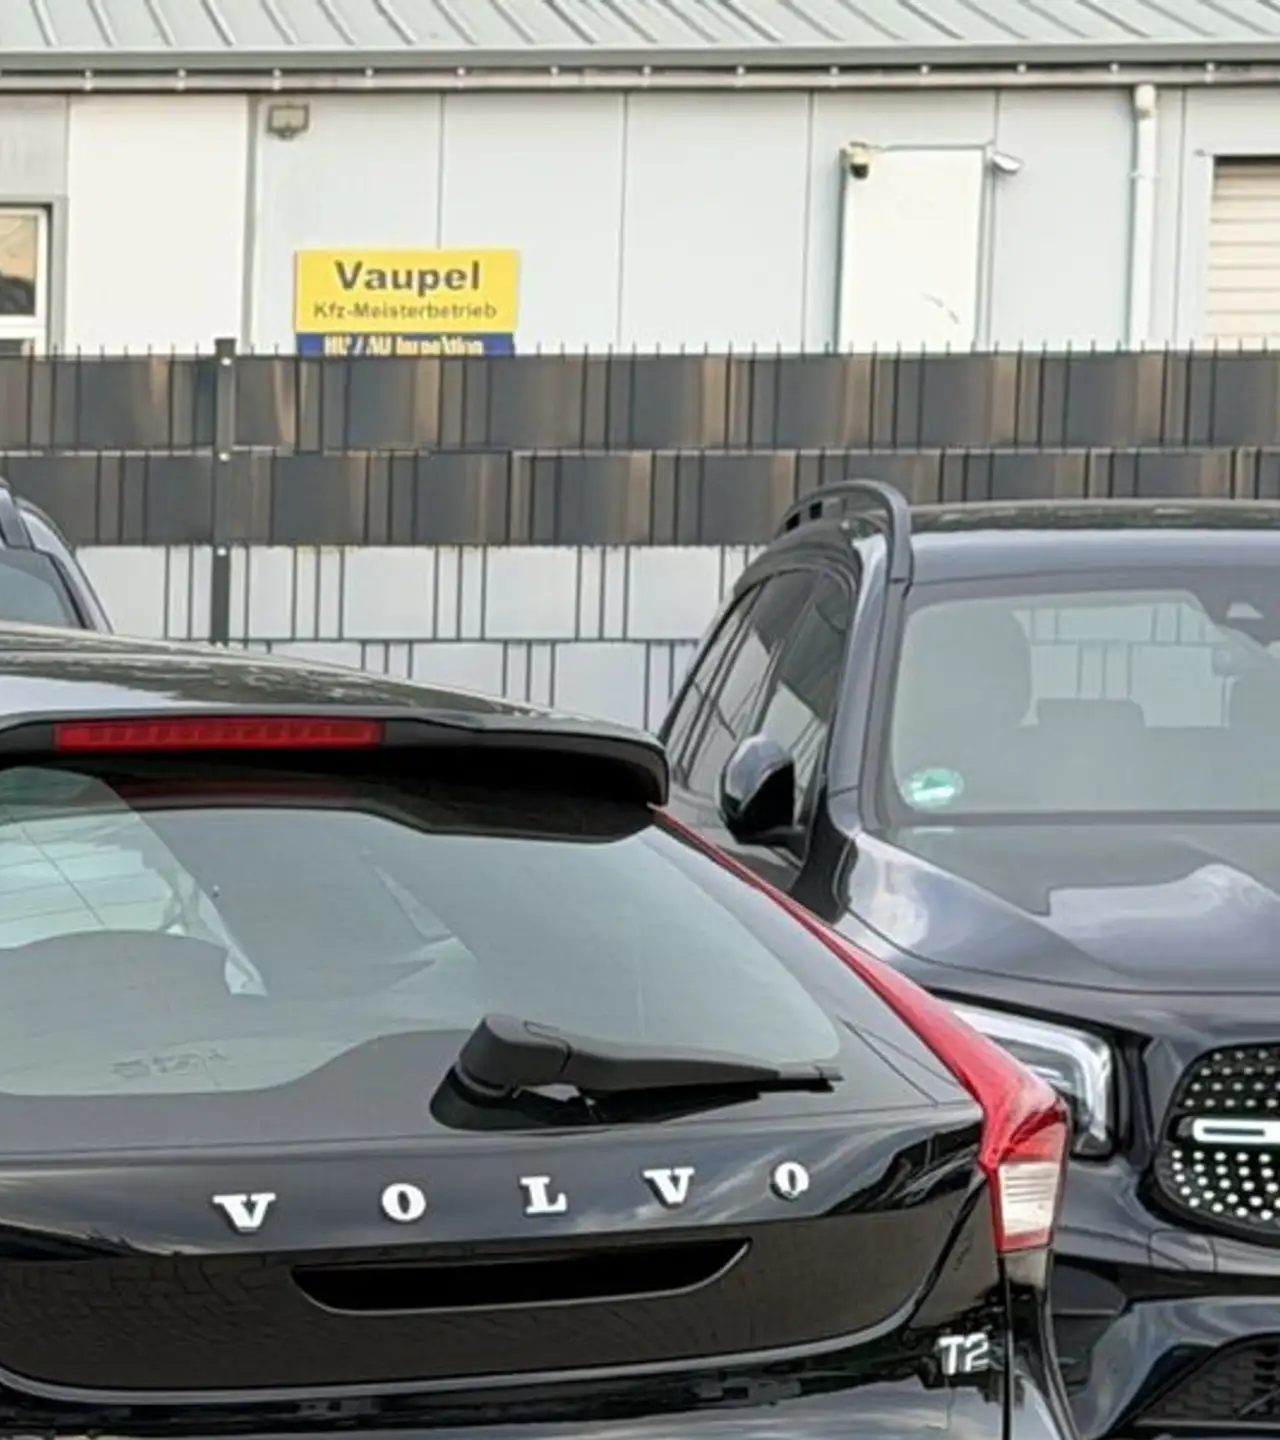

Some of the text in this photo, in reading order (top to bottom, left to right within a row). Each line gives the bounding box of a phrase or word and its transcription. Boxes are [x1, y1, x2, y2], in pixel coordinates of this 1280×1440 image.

[334, 260, 481, 297] Vaupel
[313, 301, 498, 320] Kfz-Meisterbetrieb
[213, 1161, 811, 1233] VOLVO
[938, 1332, 989, 1376] T2
